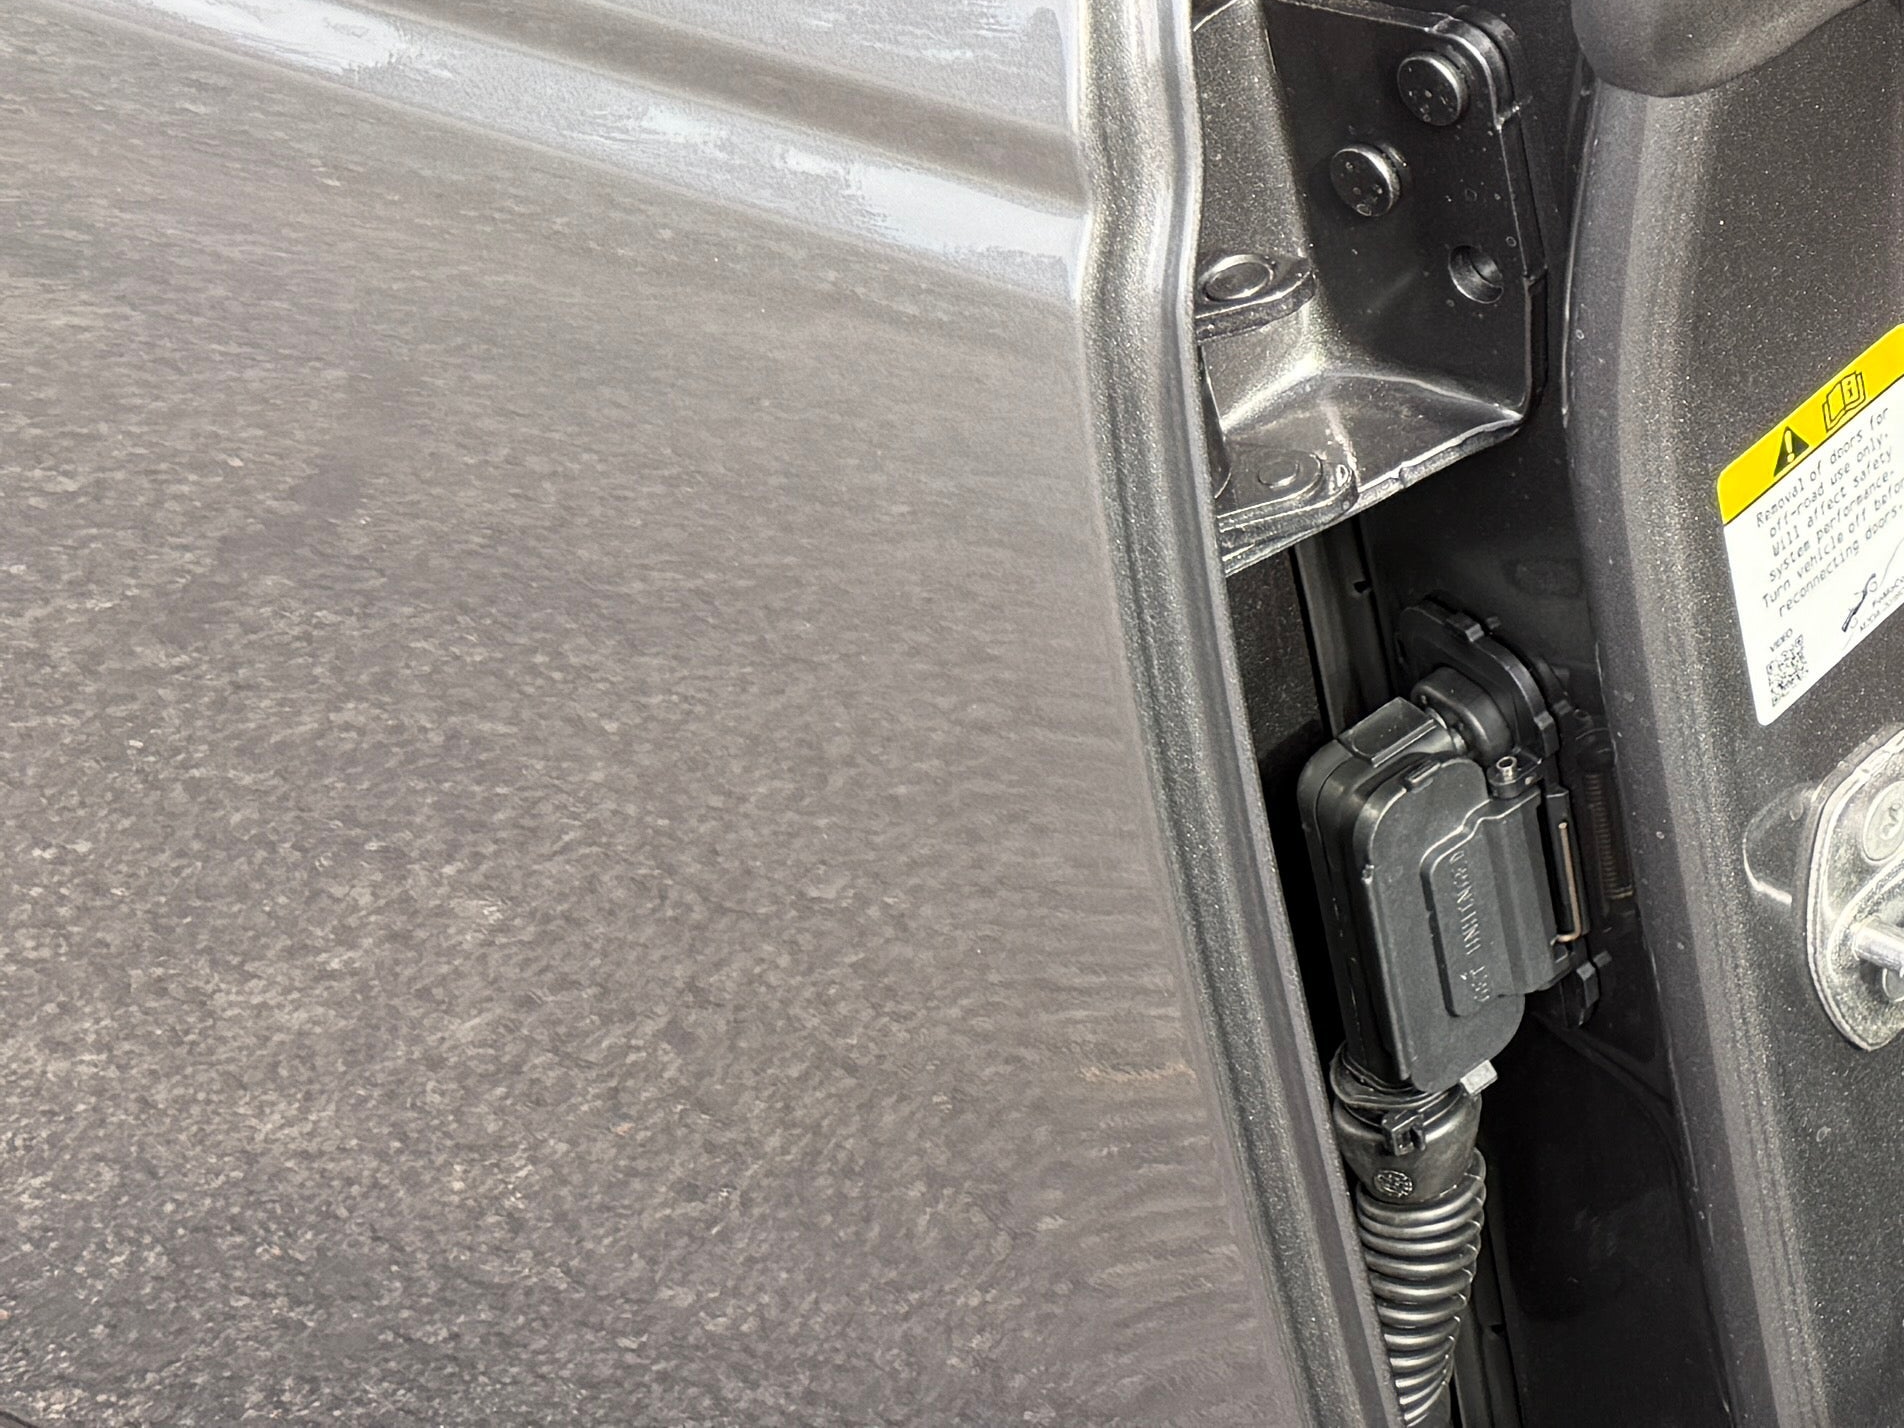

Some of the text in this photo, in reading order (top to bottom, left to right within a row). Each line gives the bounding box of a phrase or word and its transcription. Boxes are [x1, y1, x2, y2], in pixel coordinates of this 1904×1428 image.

[1756, 407, 1888, 528] Removal of doors for
[1769, 433, 1888, 538] off-road use only.
[1772, 445, 1892, 557] Will affect safety
[1762, 579, 1791, 608] Turn
[1797, 532, 1844, 579] vehicle
[1848, 508, 1866, 534] off
[1769, 469, 1895, 582] system performance.
[1778, 539, 1860, 617] reconnecting
[1865, 504, 1903, 541] doors.
